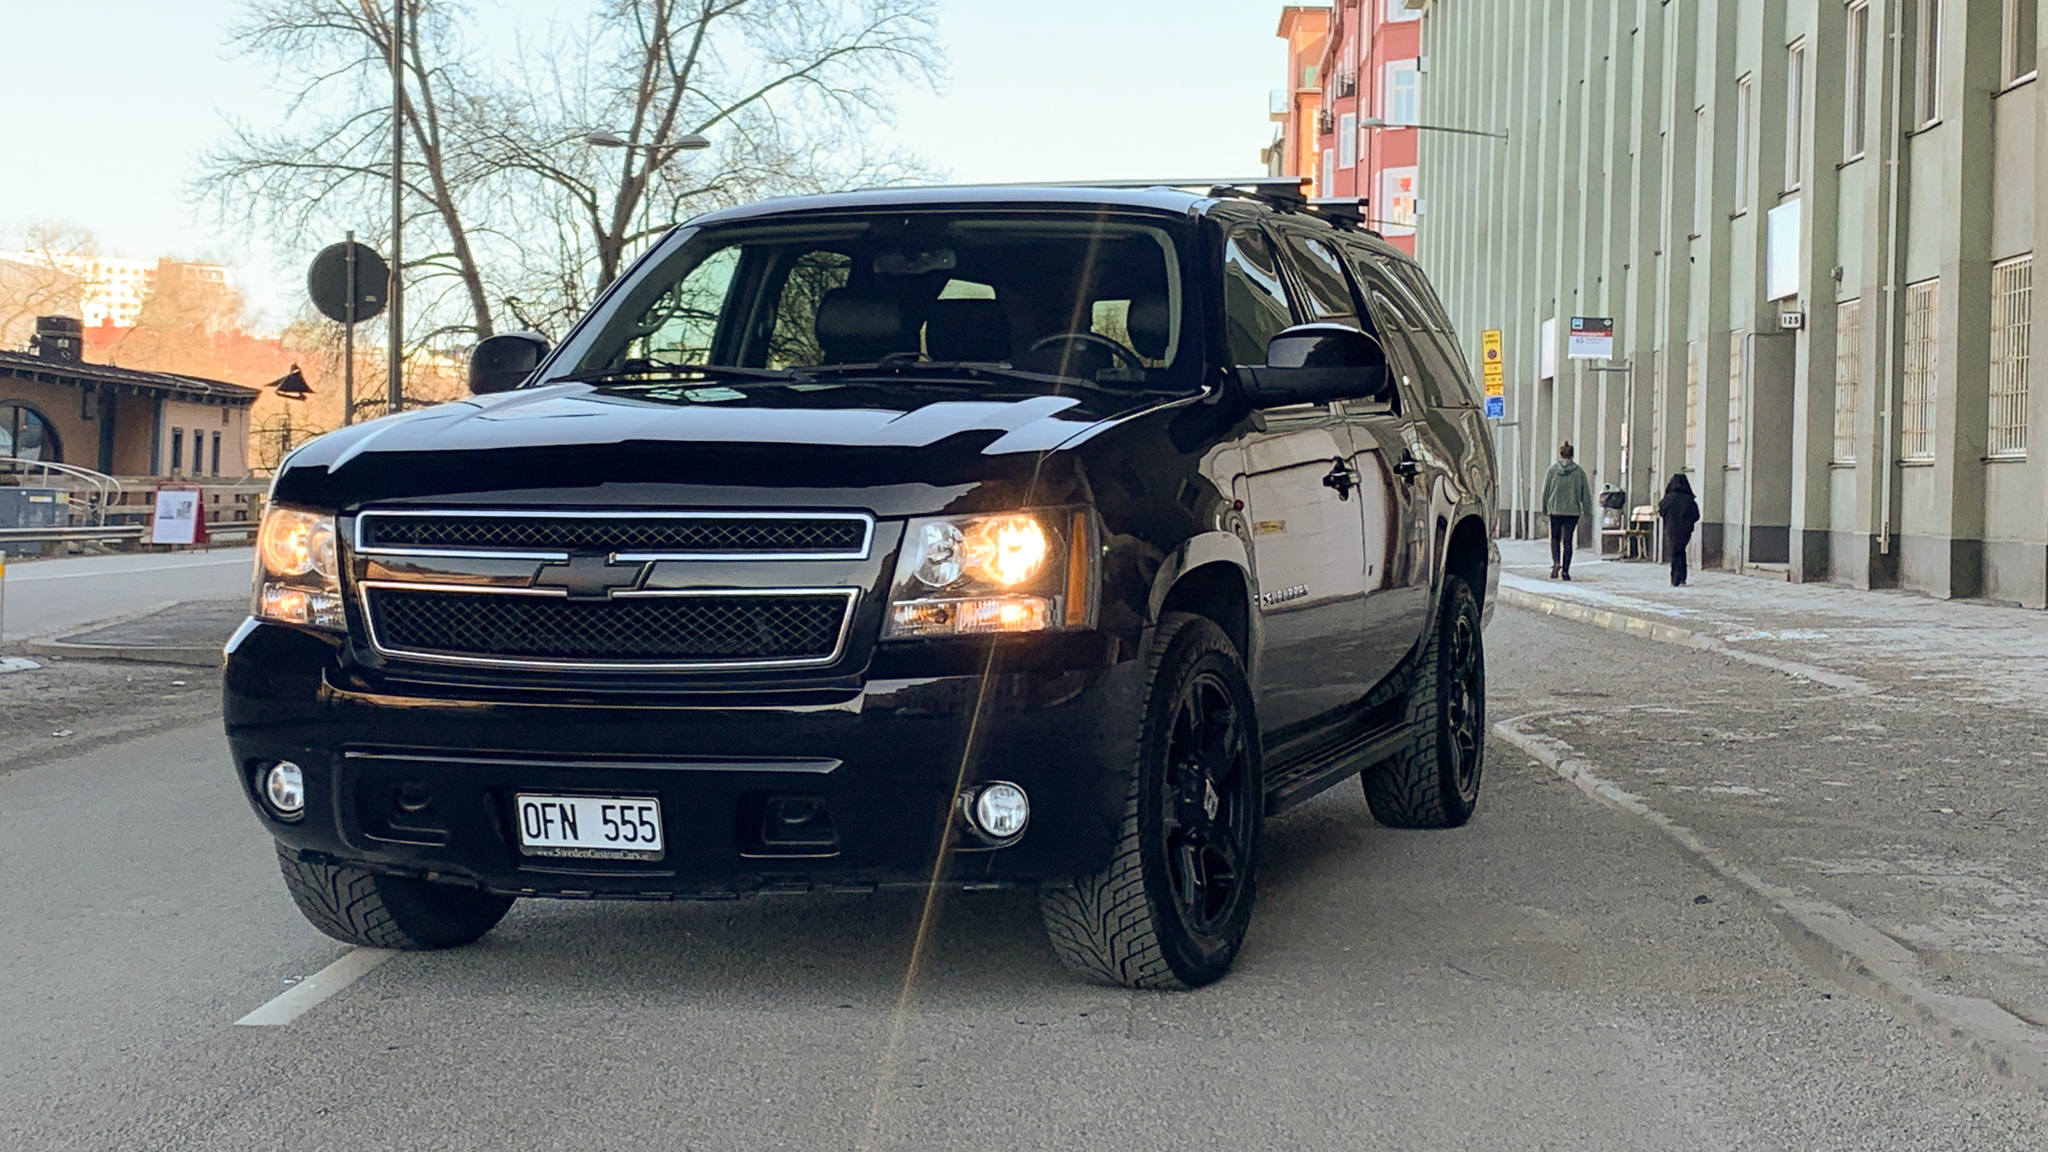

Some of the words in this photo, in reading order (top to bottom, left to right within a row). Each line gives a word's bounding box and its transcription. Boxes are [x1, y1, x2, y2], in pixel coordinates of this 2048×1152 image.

[1783, 316, 1799, 324] 125
[523, 802, 579, 841] OFN
[601, 804, 656, 843] 555
